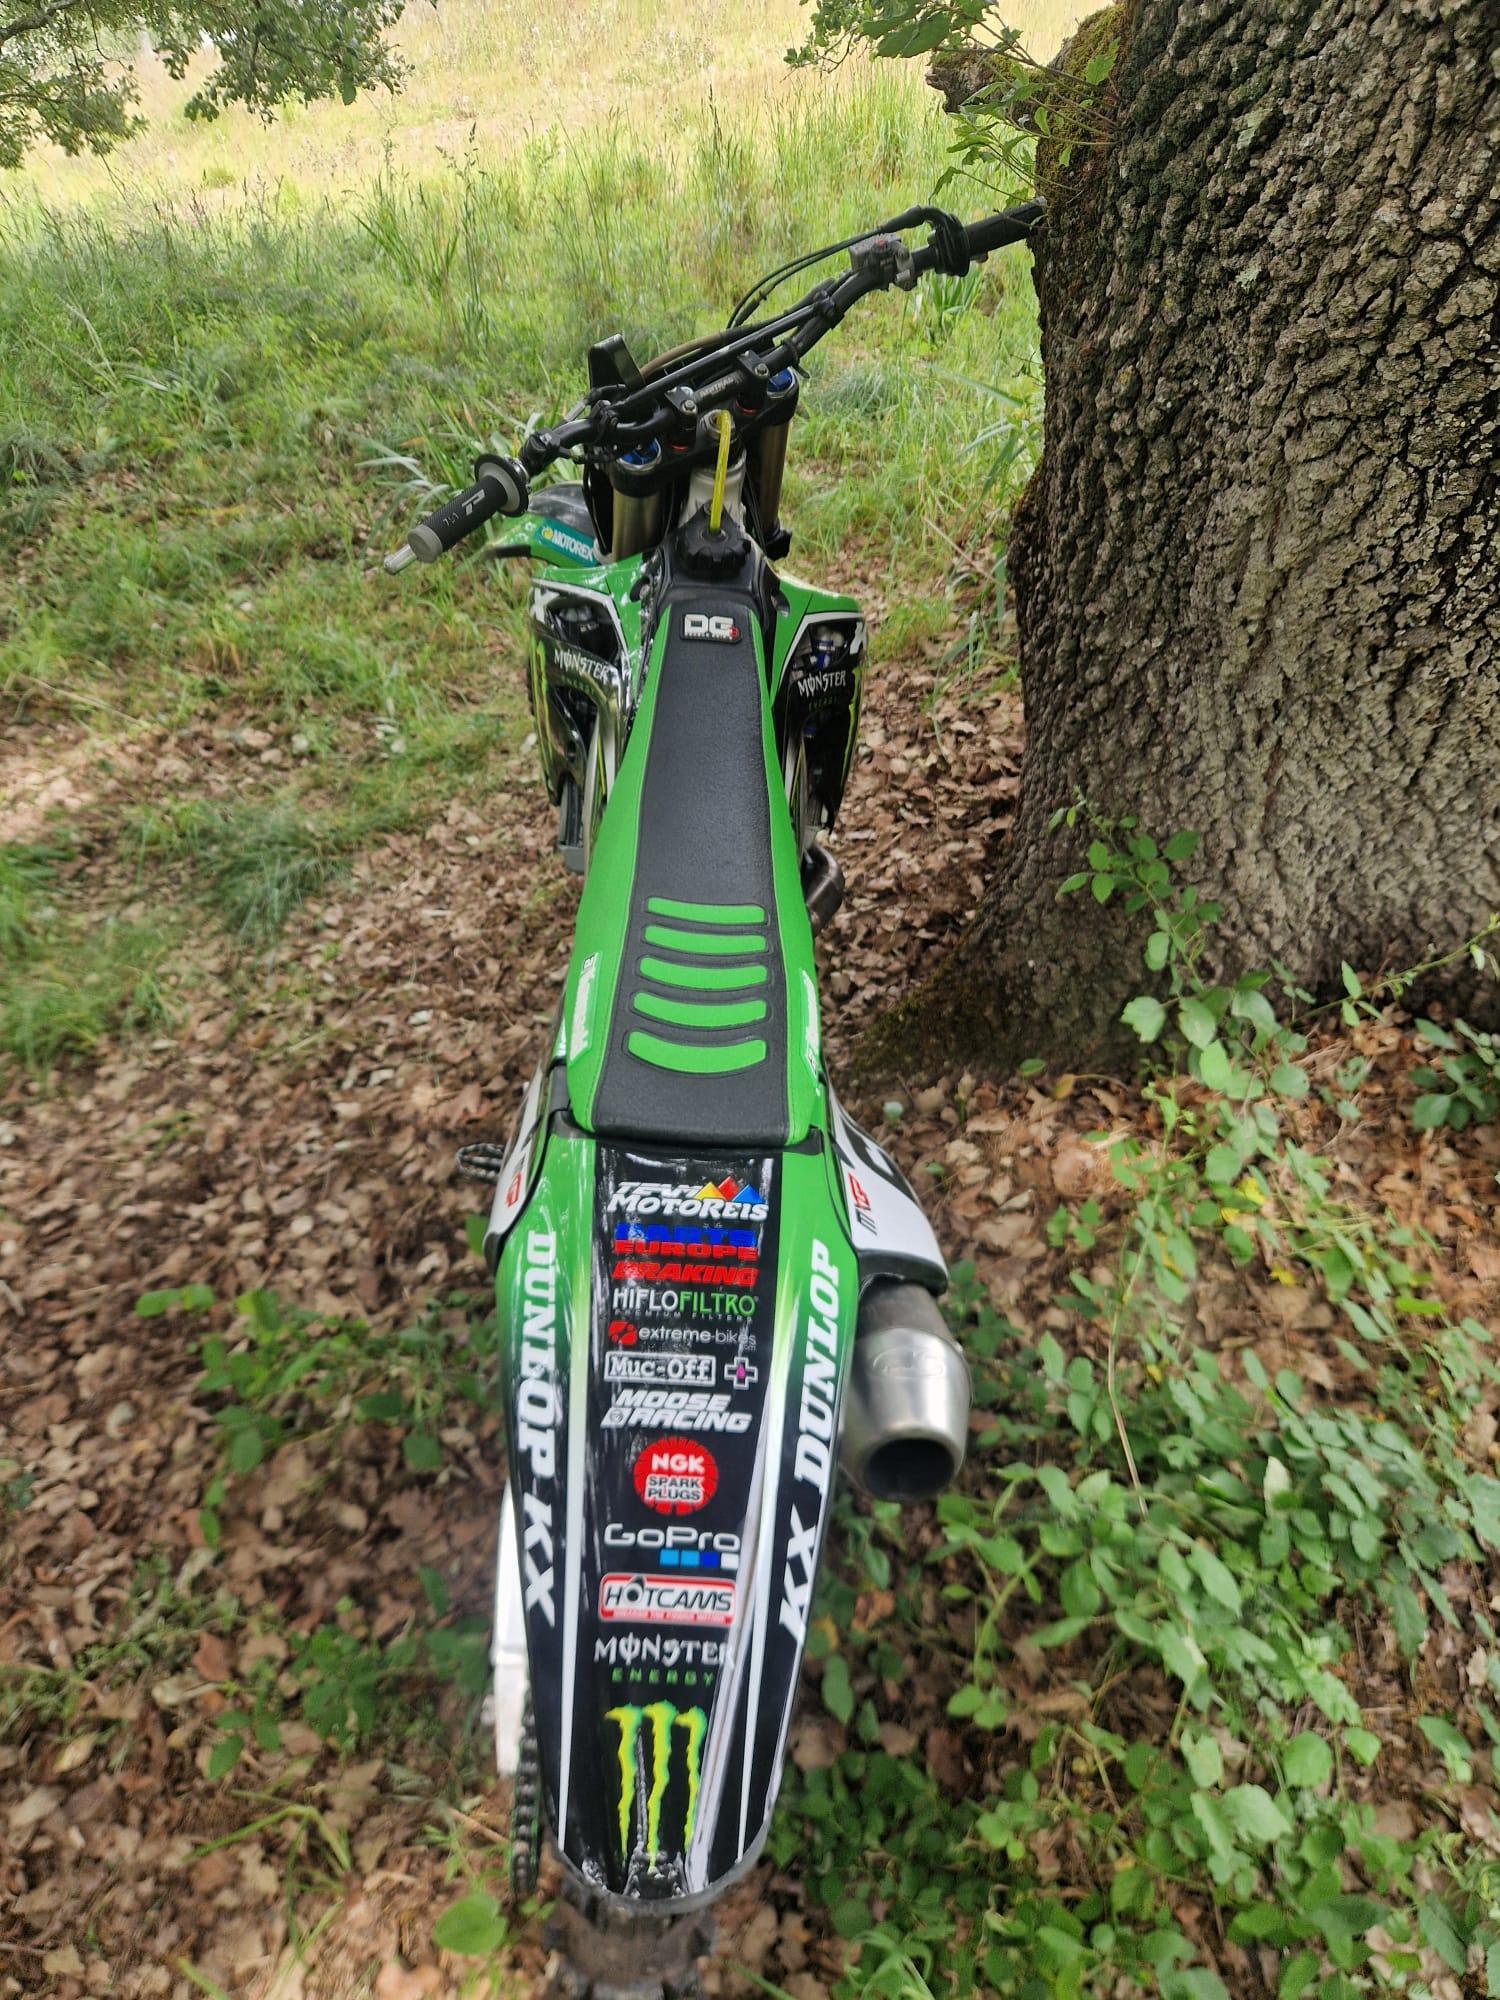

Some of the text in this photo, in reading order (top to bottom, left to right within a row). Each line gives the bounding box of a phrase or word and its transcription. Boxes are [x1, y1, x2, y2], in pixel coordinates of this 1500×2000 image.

[552, 529, 594, 562] MOTOREX
[554, 649, 612, 684] MONSTER
[797, 669, 846, 698] MONSTER
[607, 1194, 769, 1220] MOTOREIS
[613, 1240, 758, 1262] EUROPE
[612, 1261, 759, 1286] BRAKING
[613, 1289, 756, 1315] HIFLOFILTRO
[518, 1231, 558, 1479] DUNLOP
[794, 1239, 839, 1497] DUNLOP
[610, 1356, 711, 1382] Muc-Off
[616, 1389, 731, 1411] MOOSE
[628, 1408, 752, 1432] RACING
[651, 1452, 705, 1474] NGK
[646, 1487, 702, 1501] PLUGS
[647, 1475, 702, 1489] SPARK
[604, 1523, 741, 1552] GoPro
[522, 1493, 555, 1628] KX
[779, 1503, 817, 1650] KX
